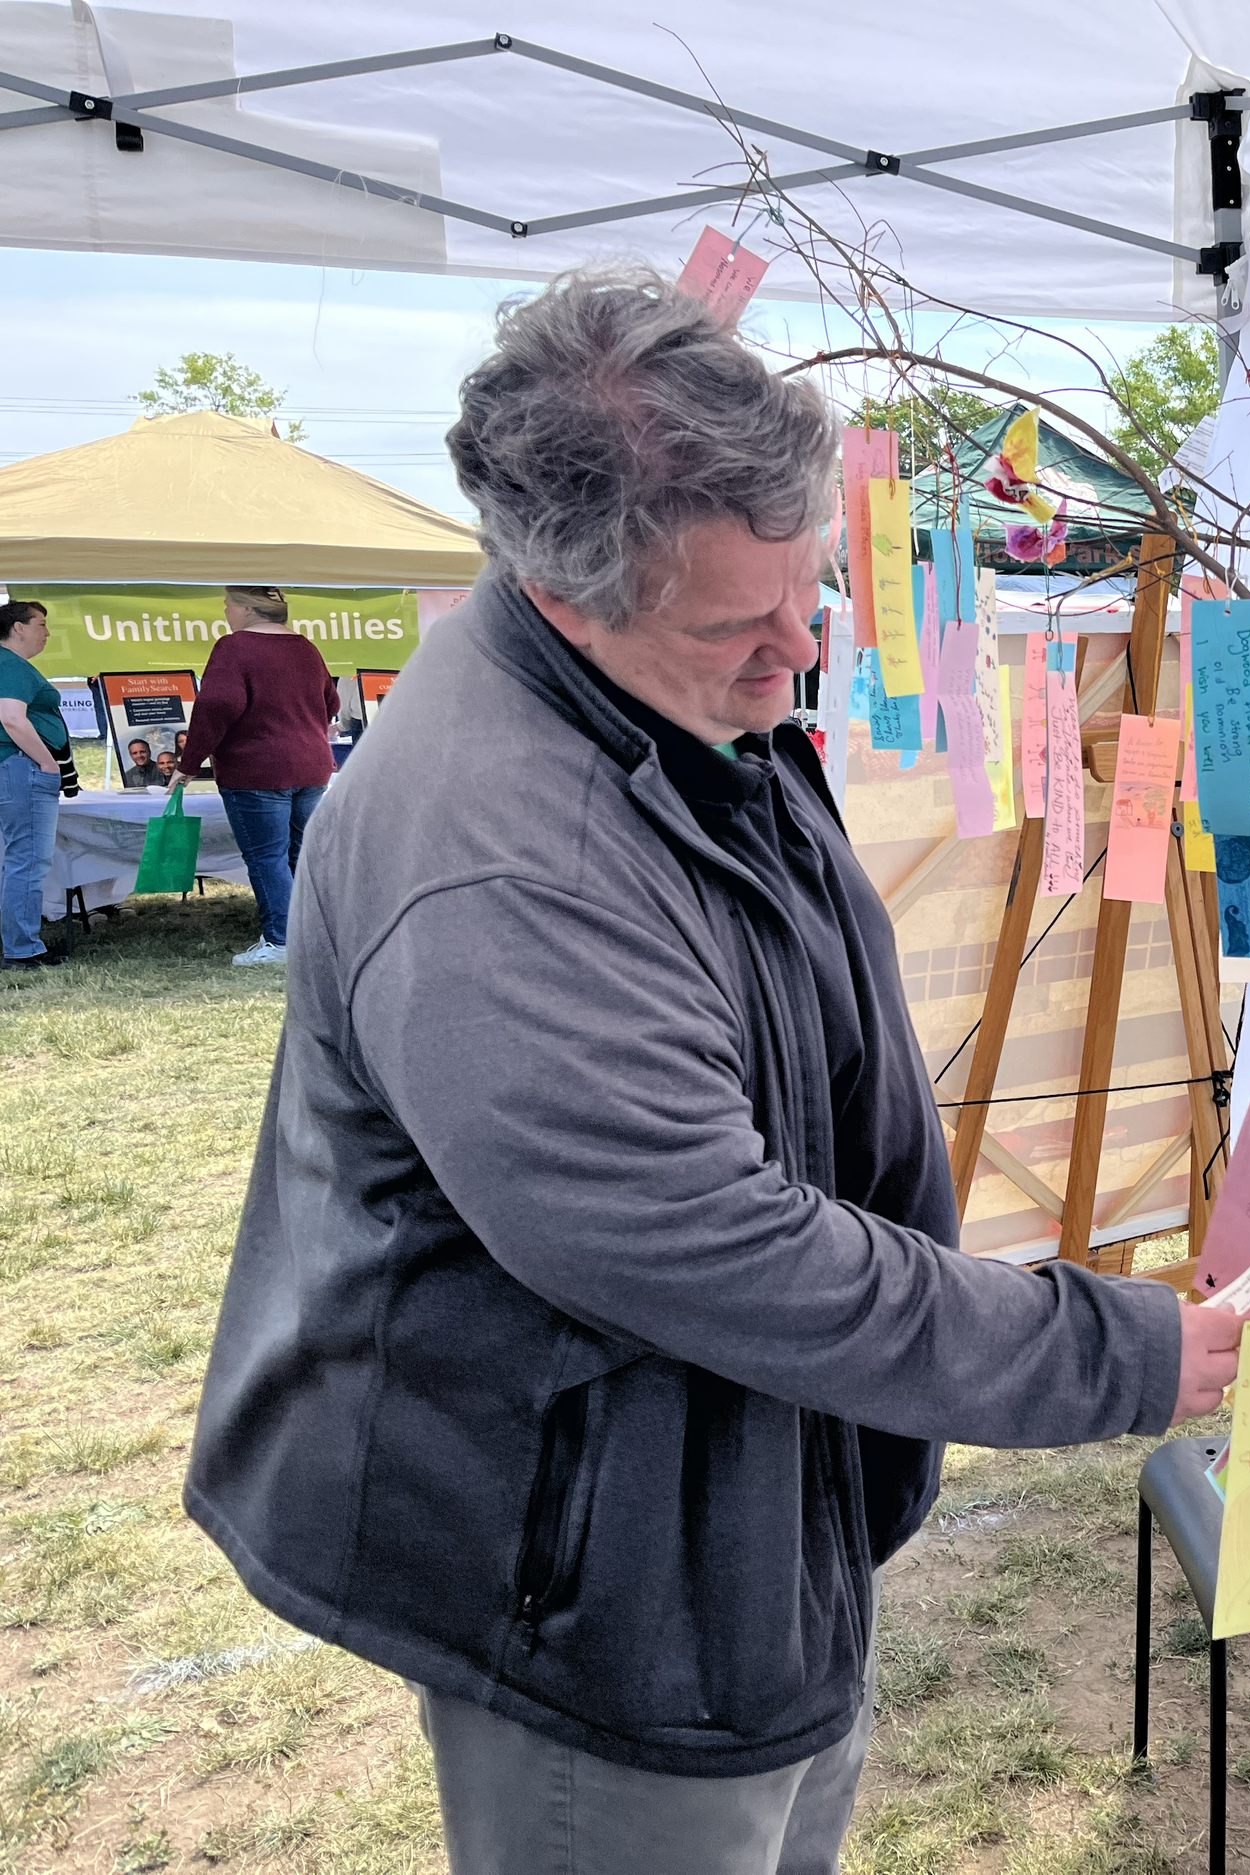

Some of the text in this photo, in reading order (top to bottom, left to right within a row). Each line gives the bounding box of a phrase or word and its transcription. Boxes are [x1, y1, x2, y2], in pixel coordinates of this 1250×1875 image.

[1066, 544, 1121, 564] Park
[296, 611, 404, 641] milies
[121, 685, 179, 694] FamilySearch
[128, 677, 169, 686] Start with
[1225, 687, 1240, 706] Be
[1051, 706, 1063, 745] Just
[1196, 711, 1211, 734] you
[1053, 746, 1063, 770] Be
[1060, 722, 1074, 793] Virginia
[1071, 751, 1080, 772] to
[1200, 745, 1215, 773] well
[1052, 777, 1064, 815] KIND
[1073, 779, 1081, 800] do
[1066, 795, 1074, 824] where
[1052, 818, 1063, 834] to
[1066, 828, 1073, 844] we
[1048, 843, 1062, 869] ALL
[1066, 807, 1083, 883] something
[1063, 851, 1075, 879] live
